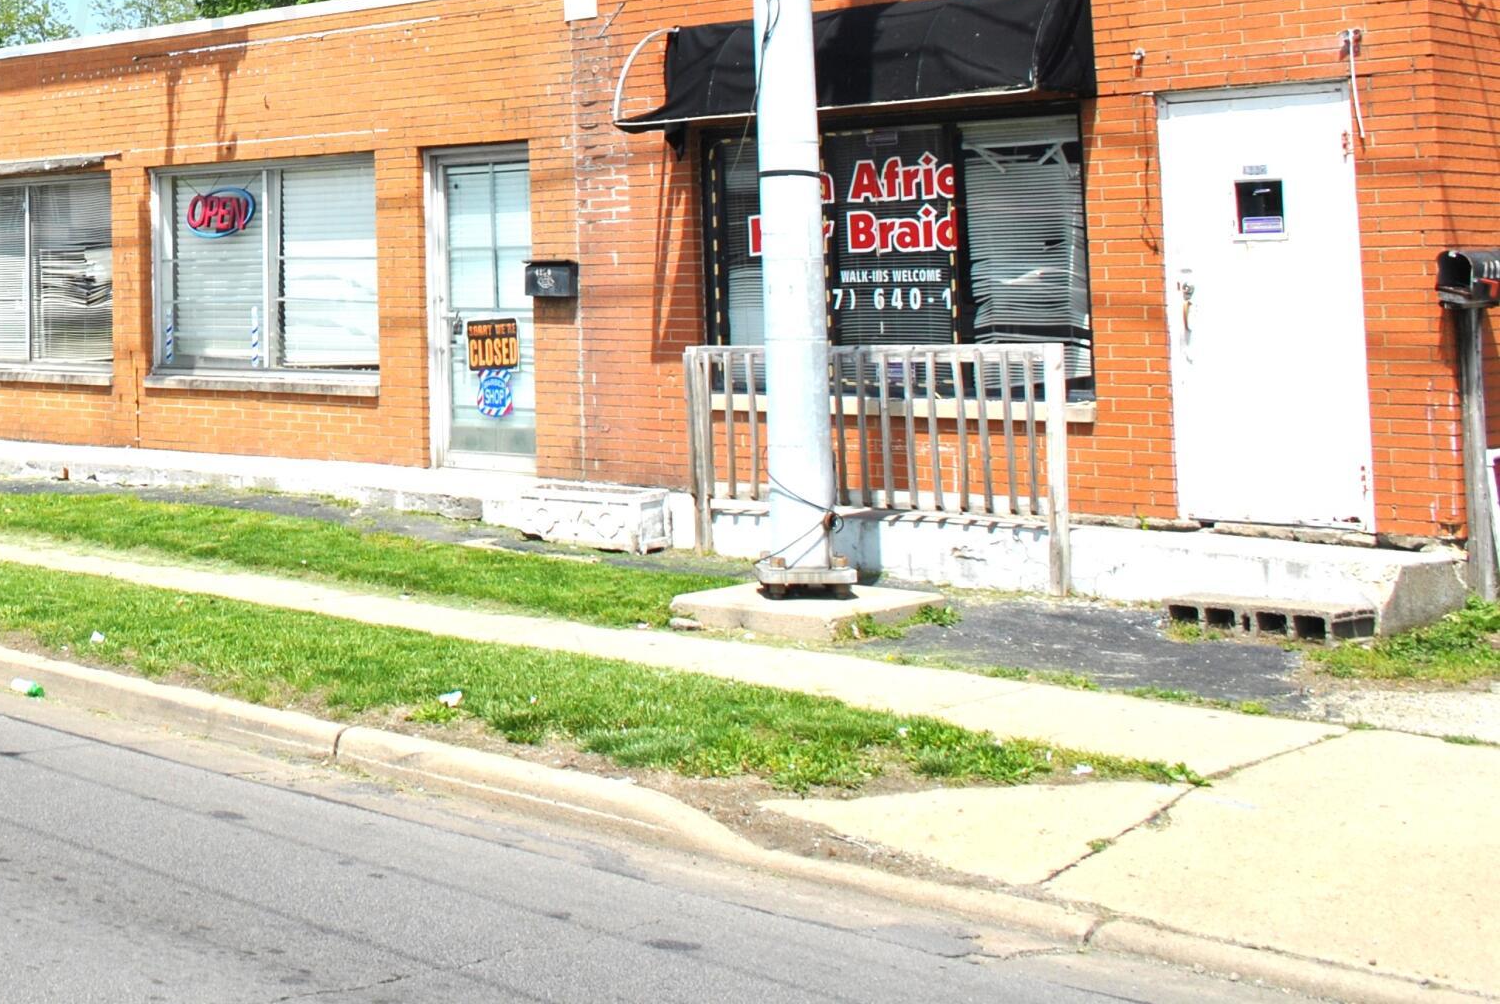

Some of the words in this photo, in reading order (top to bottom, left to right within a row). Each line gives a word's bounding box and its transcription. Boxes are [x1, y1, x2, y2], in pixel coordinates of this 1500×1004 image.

[187, 195, 248, 231] OPEN
[840, 269, 889, 283] WALK-INS
[892, 269, 942, 282] WELCOME
[468, 336, 518, 367] CLOSED
[484, 388, 505, 405] SHOP
